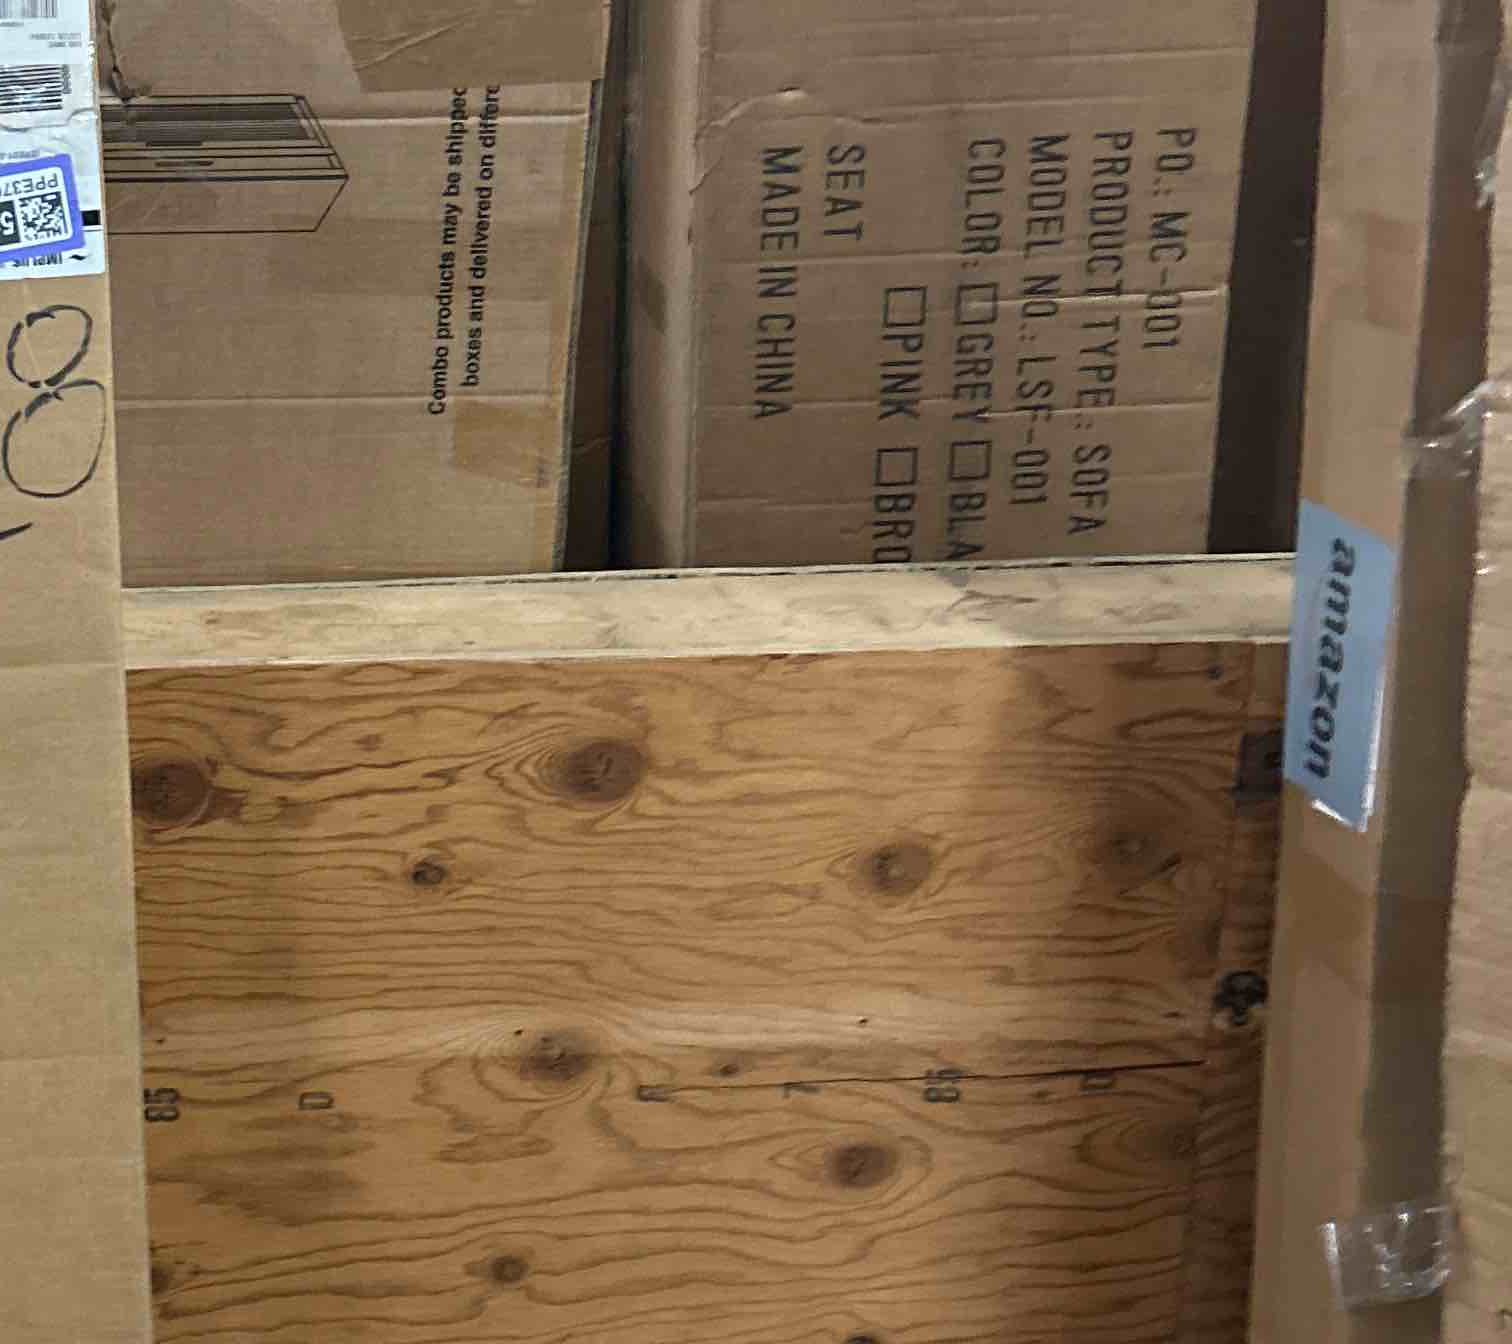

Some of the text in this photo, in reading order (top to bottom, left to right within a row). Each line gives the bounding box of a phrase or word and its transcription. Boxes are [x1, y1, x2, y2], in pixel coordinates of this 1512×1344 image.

[442, 171, 462, 198] be
[479, 154, 495, 181] on
[824, 143, 866, 241] SEAT
[1023, 133, 1071, 259] MODEL
[1085, 131, 1134, 297] PRODUCT
[442, 202, 464, 245] may
[469, 186, 493, 280] delivered
[435, 250, 456, 340] products
[468, 285, 487, 322] and
[753, 145, 804, 420] MADE IN CHINA
[1142, 210, 1191, 350] MC-001
[427, 346, 449, 415] Combo
[461, 327, 483, 388] boxes
[946, 137, 1007, 562] COLOR: GREY BLA
[871, 332, 925, 563] PINK BRO
[1009, 355, 1058, 505] LSF-001
[1067, 443, 1113, 536] SOFA
[1303, 537, 1357, 780] amazon
